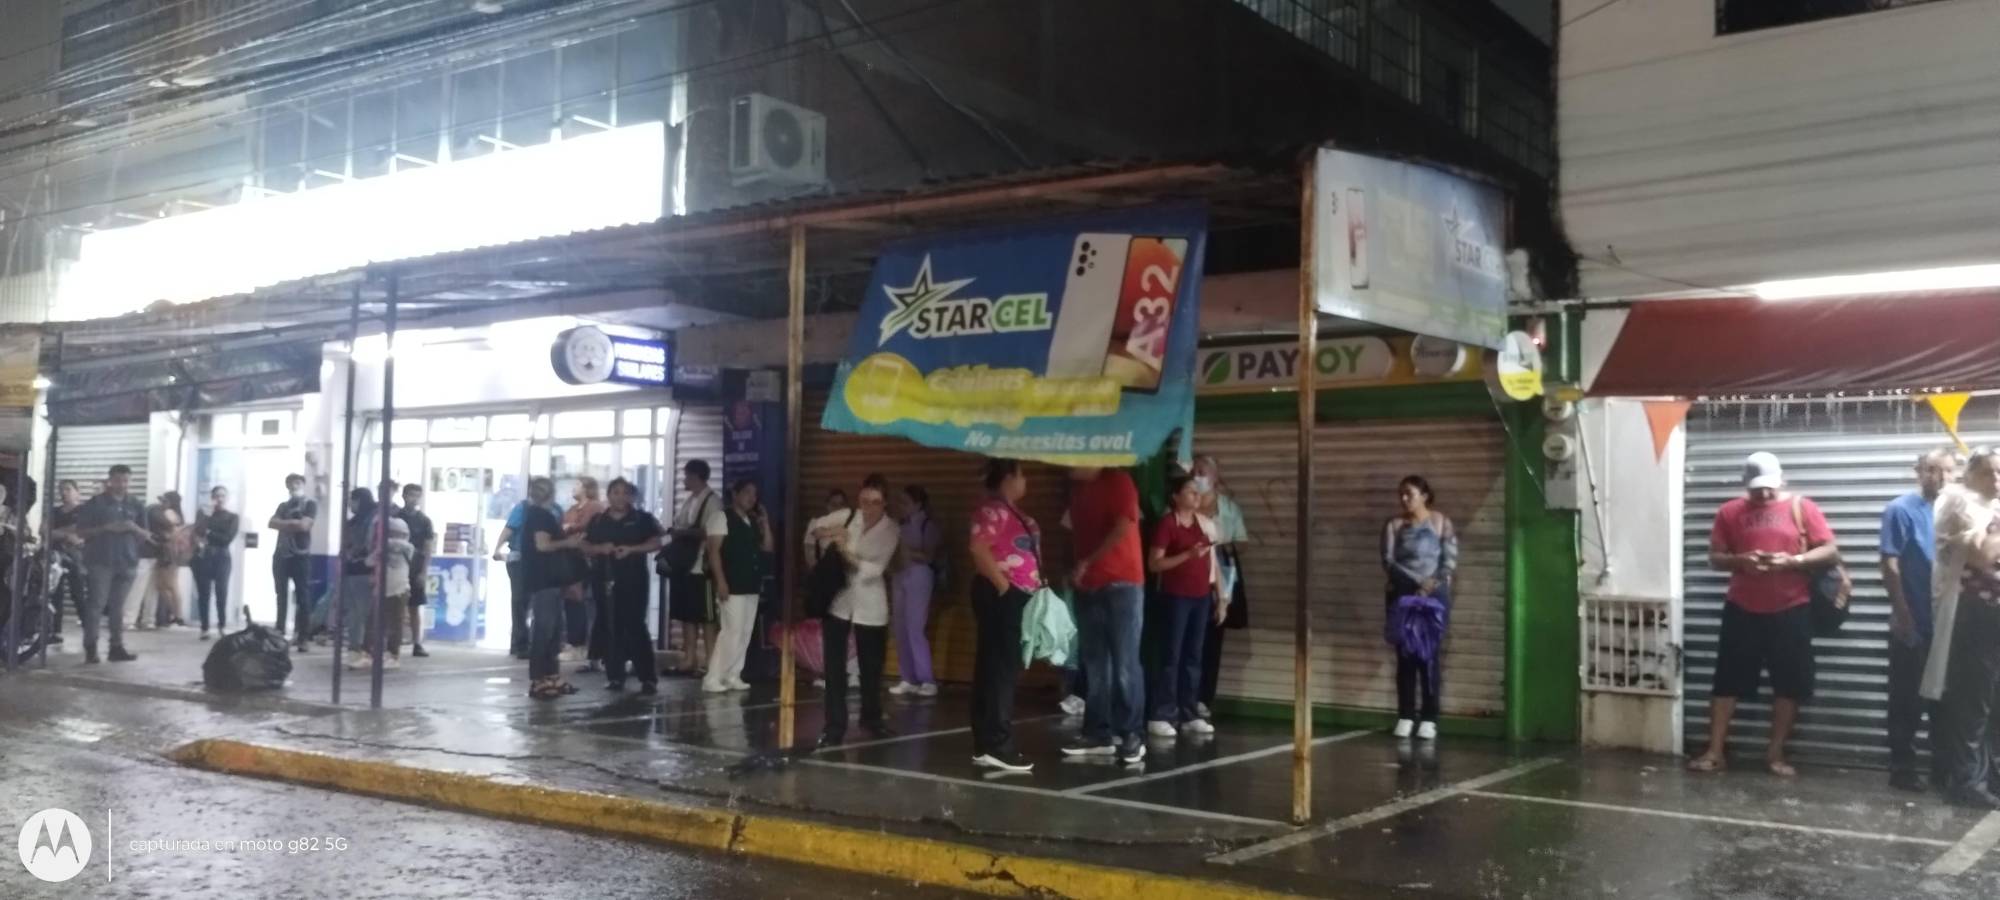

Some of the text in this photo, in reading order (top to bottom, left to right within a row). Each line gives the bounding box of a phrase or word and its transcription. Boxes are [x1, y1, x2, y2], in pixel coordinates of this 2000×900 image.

[915, 298, 1047, 333] STAR CEL
[1126, 264, 1180, 373] A32
[964, 430, 1133, 450] No necesitas aval
